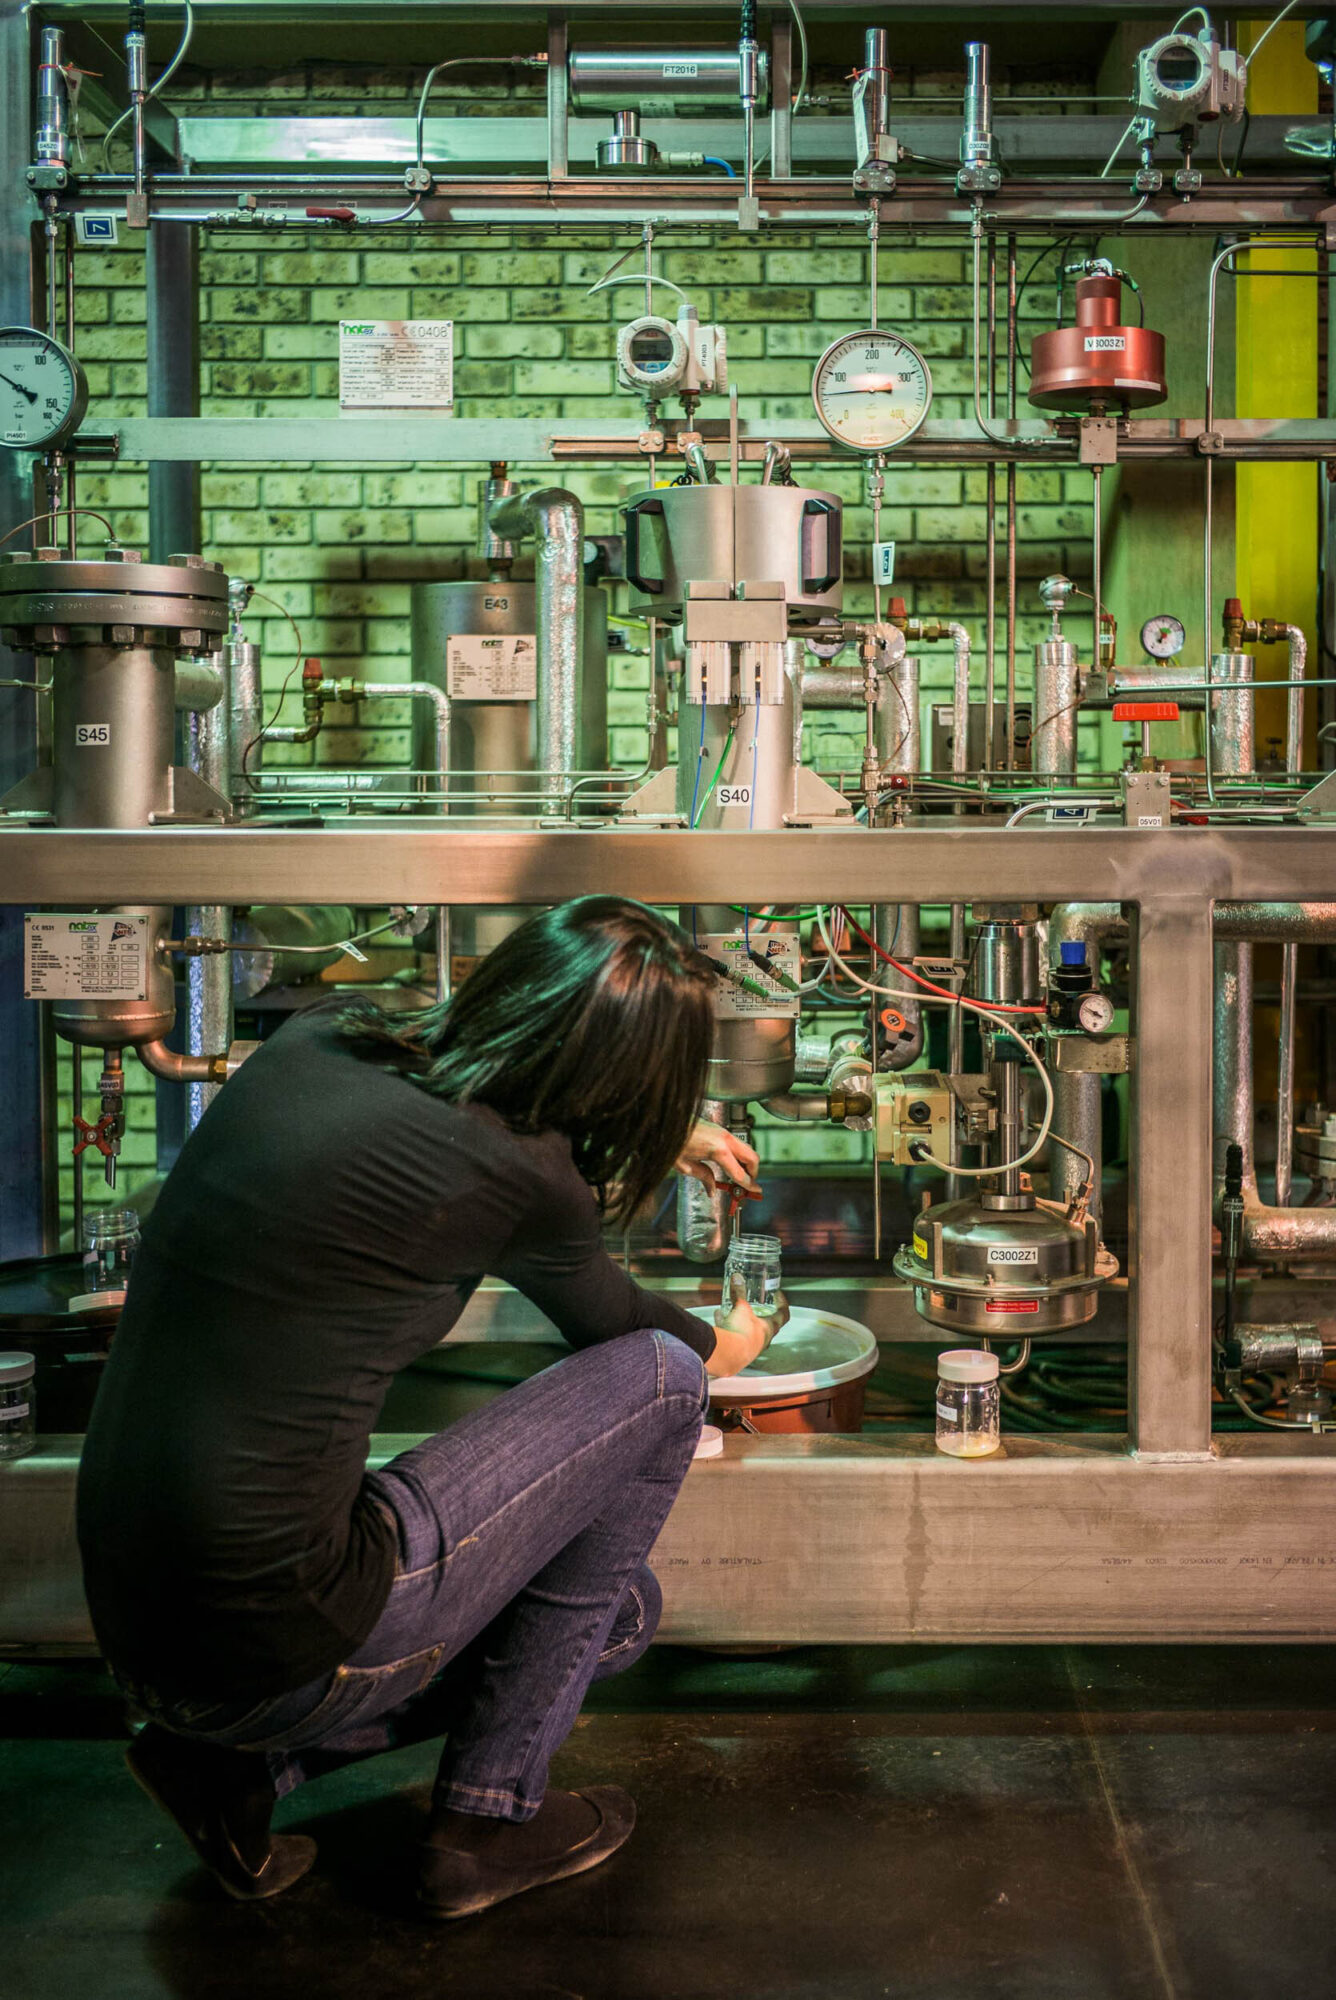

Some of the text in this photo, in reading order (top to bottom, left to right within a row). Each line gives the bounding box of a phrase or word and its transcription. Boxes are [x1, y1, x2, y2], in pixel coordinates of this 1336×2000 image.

[664, 65, 696, 74] FT2016
[418, 326, 448, 337] 0408
[34, 355, 47, 365] 100
[865, 349, 880, 360] 200
[834, 372, 847, 382] 100
[898, 372, 911, 382] 300
[46, 398, 58, 408] 150
[484, 598, 508, 610] E43
[78, 727, 107, 742] S45
[720, 788, 750, 803] S40
[990, 1250, 1036, 1261] C3002Z1
